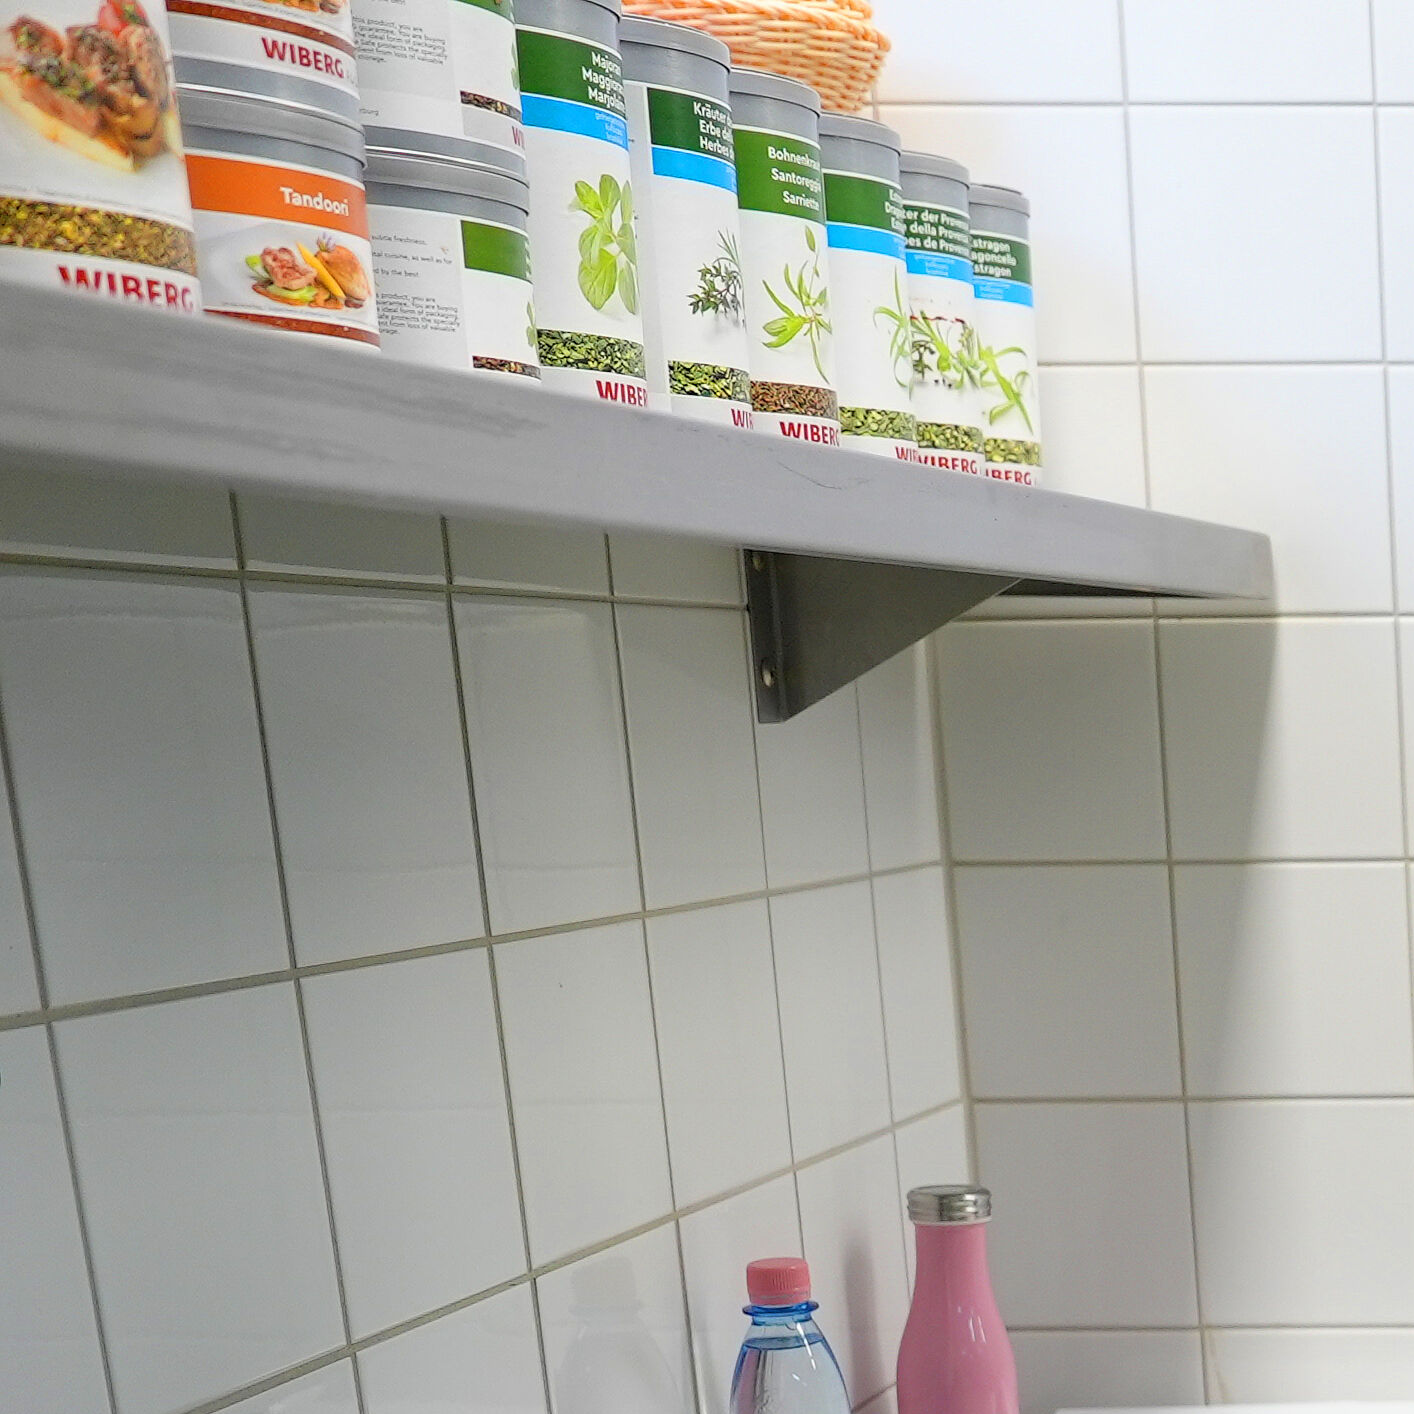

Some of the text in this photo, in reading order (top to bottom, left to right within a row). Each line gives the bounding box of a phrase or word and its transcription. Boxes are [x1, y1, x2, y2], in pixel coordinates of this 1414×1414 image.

[261, 36, 345, 79] WIBERG
[699, 120, 721, 138] Erbe
[279, 186, 350, 216] Tandoori
[921, 210, 939, 224] der
[909, 221, 937, 236] della
[924, 238, 938, 250] de
[973, 238, 1011, 253] stragon
[974, 264, 1012, 278] stragon
